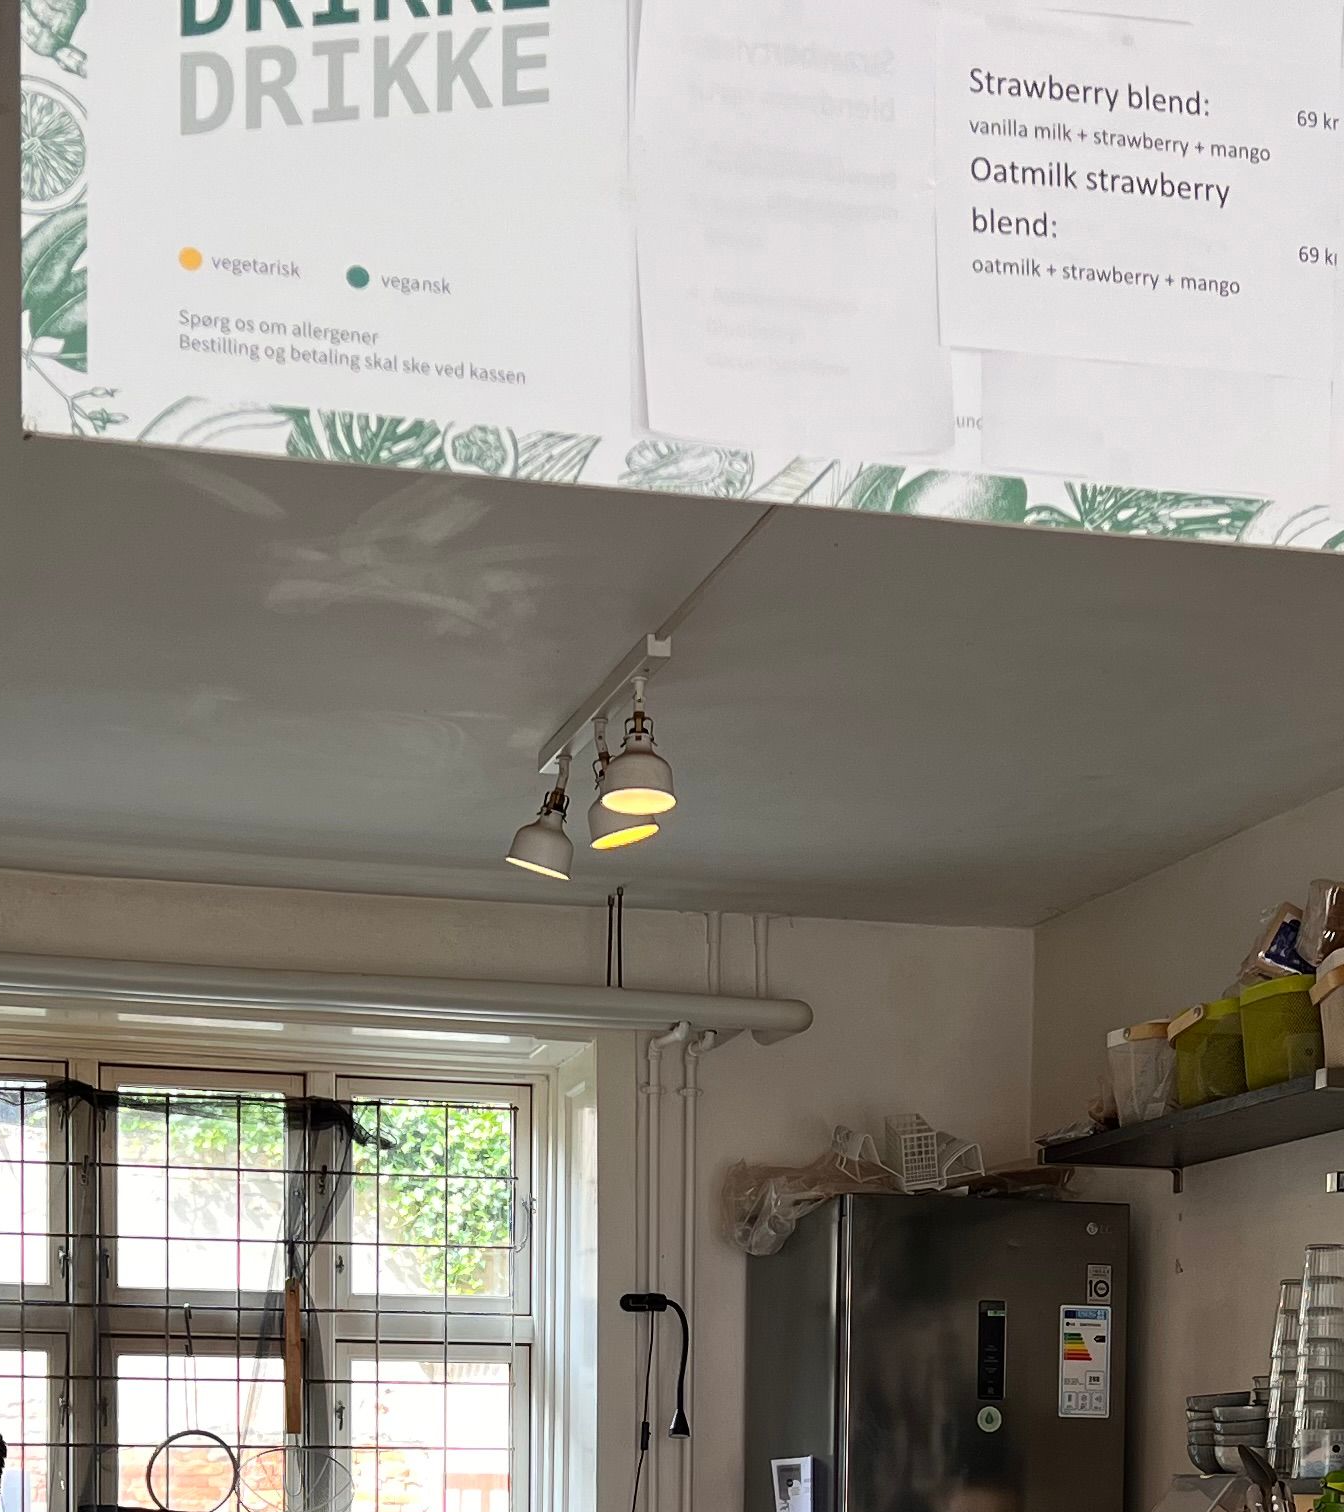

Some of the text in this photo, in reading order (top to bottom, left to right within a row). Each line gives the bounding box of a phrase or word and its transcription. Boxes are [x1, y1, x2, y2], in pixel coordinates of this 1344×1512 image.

[180, 22, 549, 135] DRIKKE
[970, 68, 1209, 117] Strawberry blend:
[1297, 111, 1339, 131] 69 kr
[969, 118, 1270, 164] vanilla milk strawberry mango
[971, 156, 1230, 208] Oatmilk strawberry
[972, 207, 1057, 238] blend:
[211, 255, 301, 279] vegetarisk
[1299, 246, 1320, 263] 69
[381, 274, 450, 295] vegansk
[972, 258, 1240, 297] oatmilk strawberry mango
[179, 309, 378, 346] Spørg os om allergener
[179, 334, 526, 384] Bestilling og betaling skal ske ved kassen
